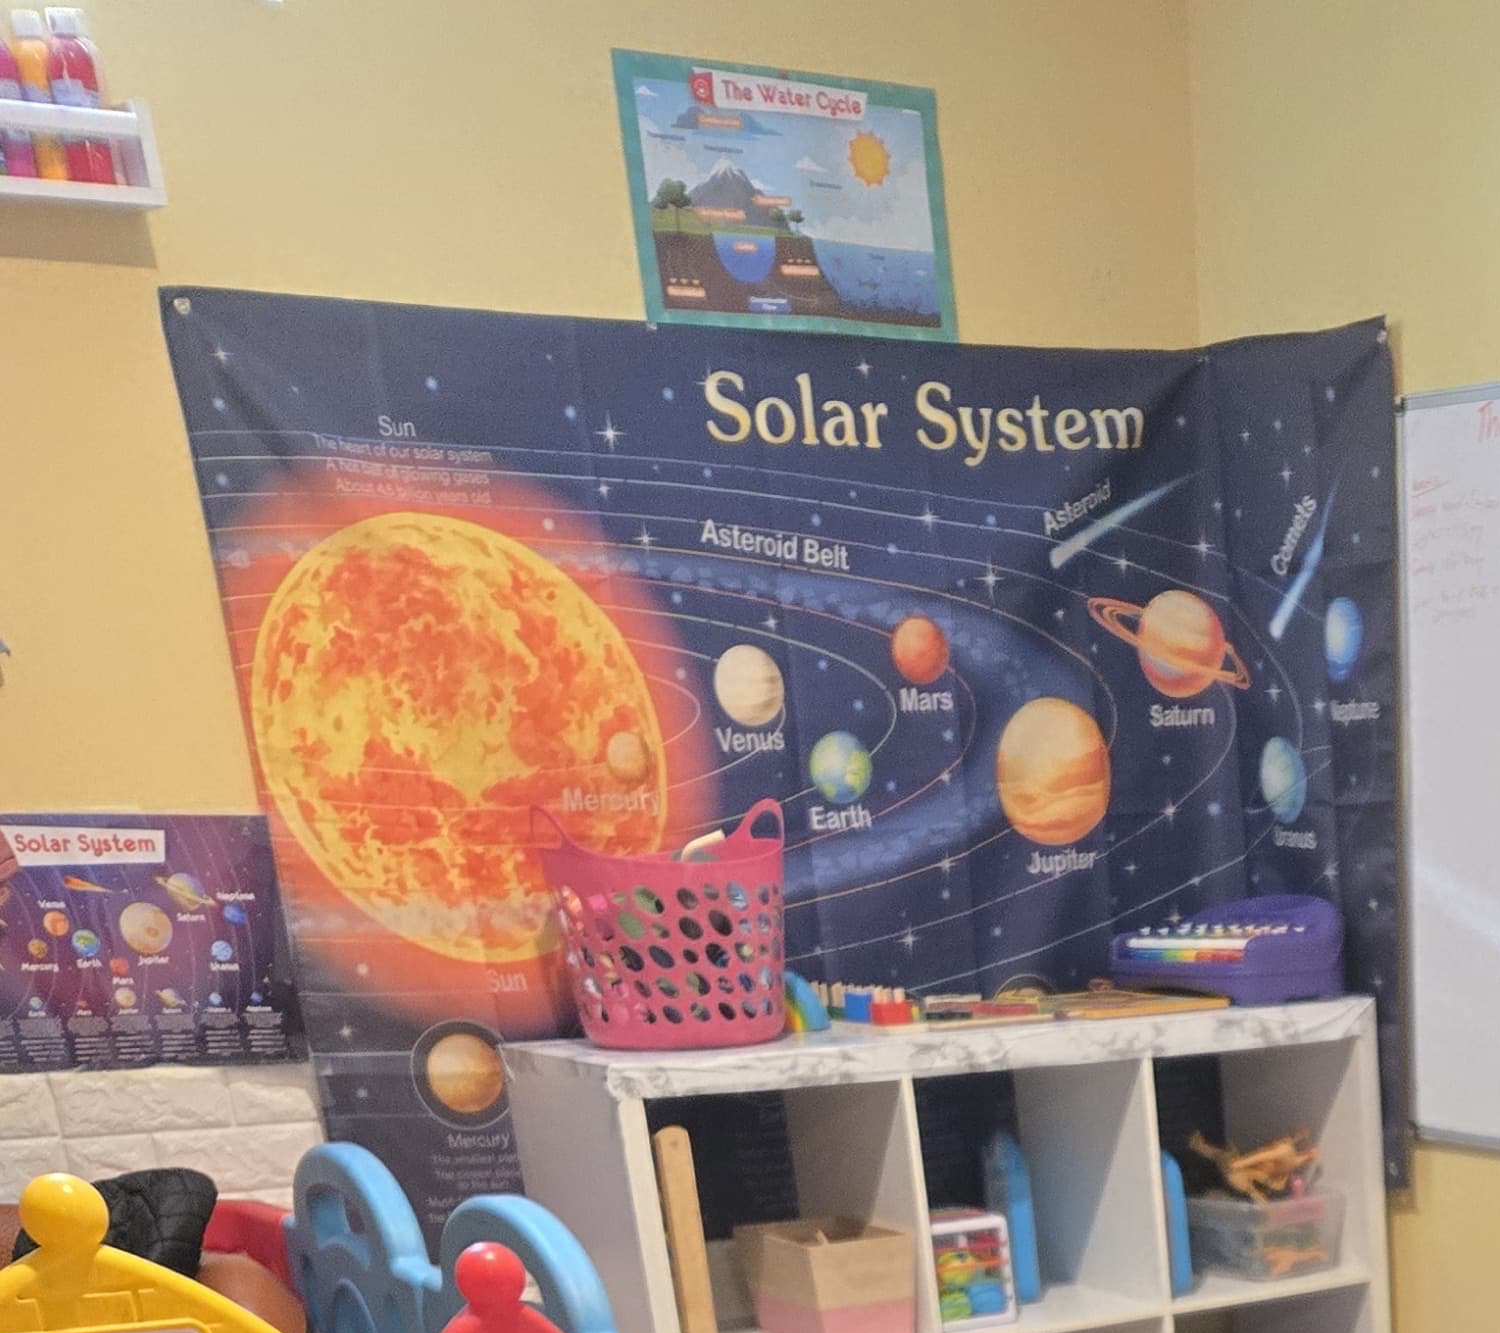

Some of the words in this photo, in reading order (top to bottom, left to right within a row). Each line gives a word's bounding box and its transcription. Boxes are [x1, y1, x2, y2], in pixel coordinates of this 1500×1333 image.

[721, 78, 753, 102] The
[756, 82, 811, 107] Water
[815, 92, 862, 117] Cycle
[377, 414, 416, 437] Sun
[704, 370, 888, 449] Solar
[916, 381, 1145, 467] System
[1043, 477, 1112, 536] Asteroid
[701, 519, 798, 562] Asteroid
[803, 536, 850, 571] Belt
[900, 688, 954, 712] Mars
[1149, 704, 1216, 729] Saturn
[715, 727, 785, 754] Venus
[562, 786, 660, 817] Mercury
[810, 806, 872, 831] Earth
[14, 833, 71, 854] Solar
[77, 834, 156, 858] System
[1026, 848, 1097, 877] Jupiter
[486, 969, 528, 993] Sun
[447, 1132, 511, 1150] Mercury
